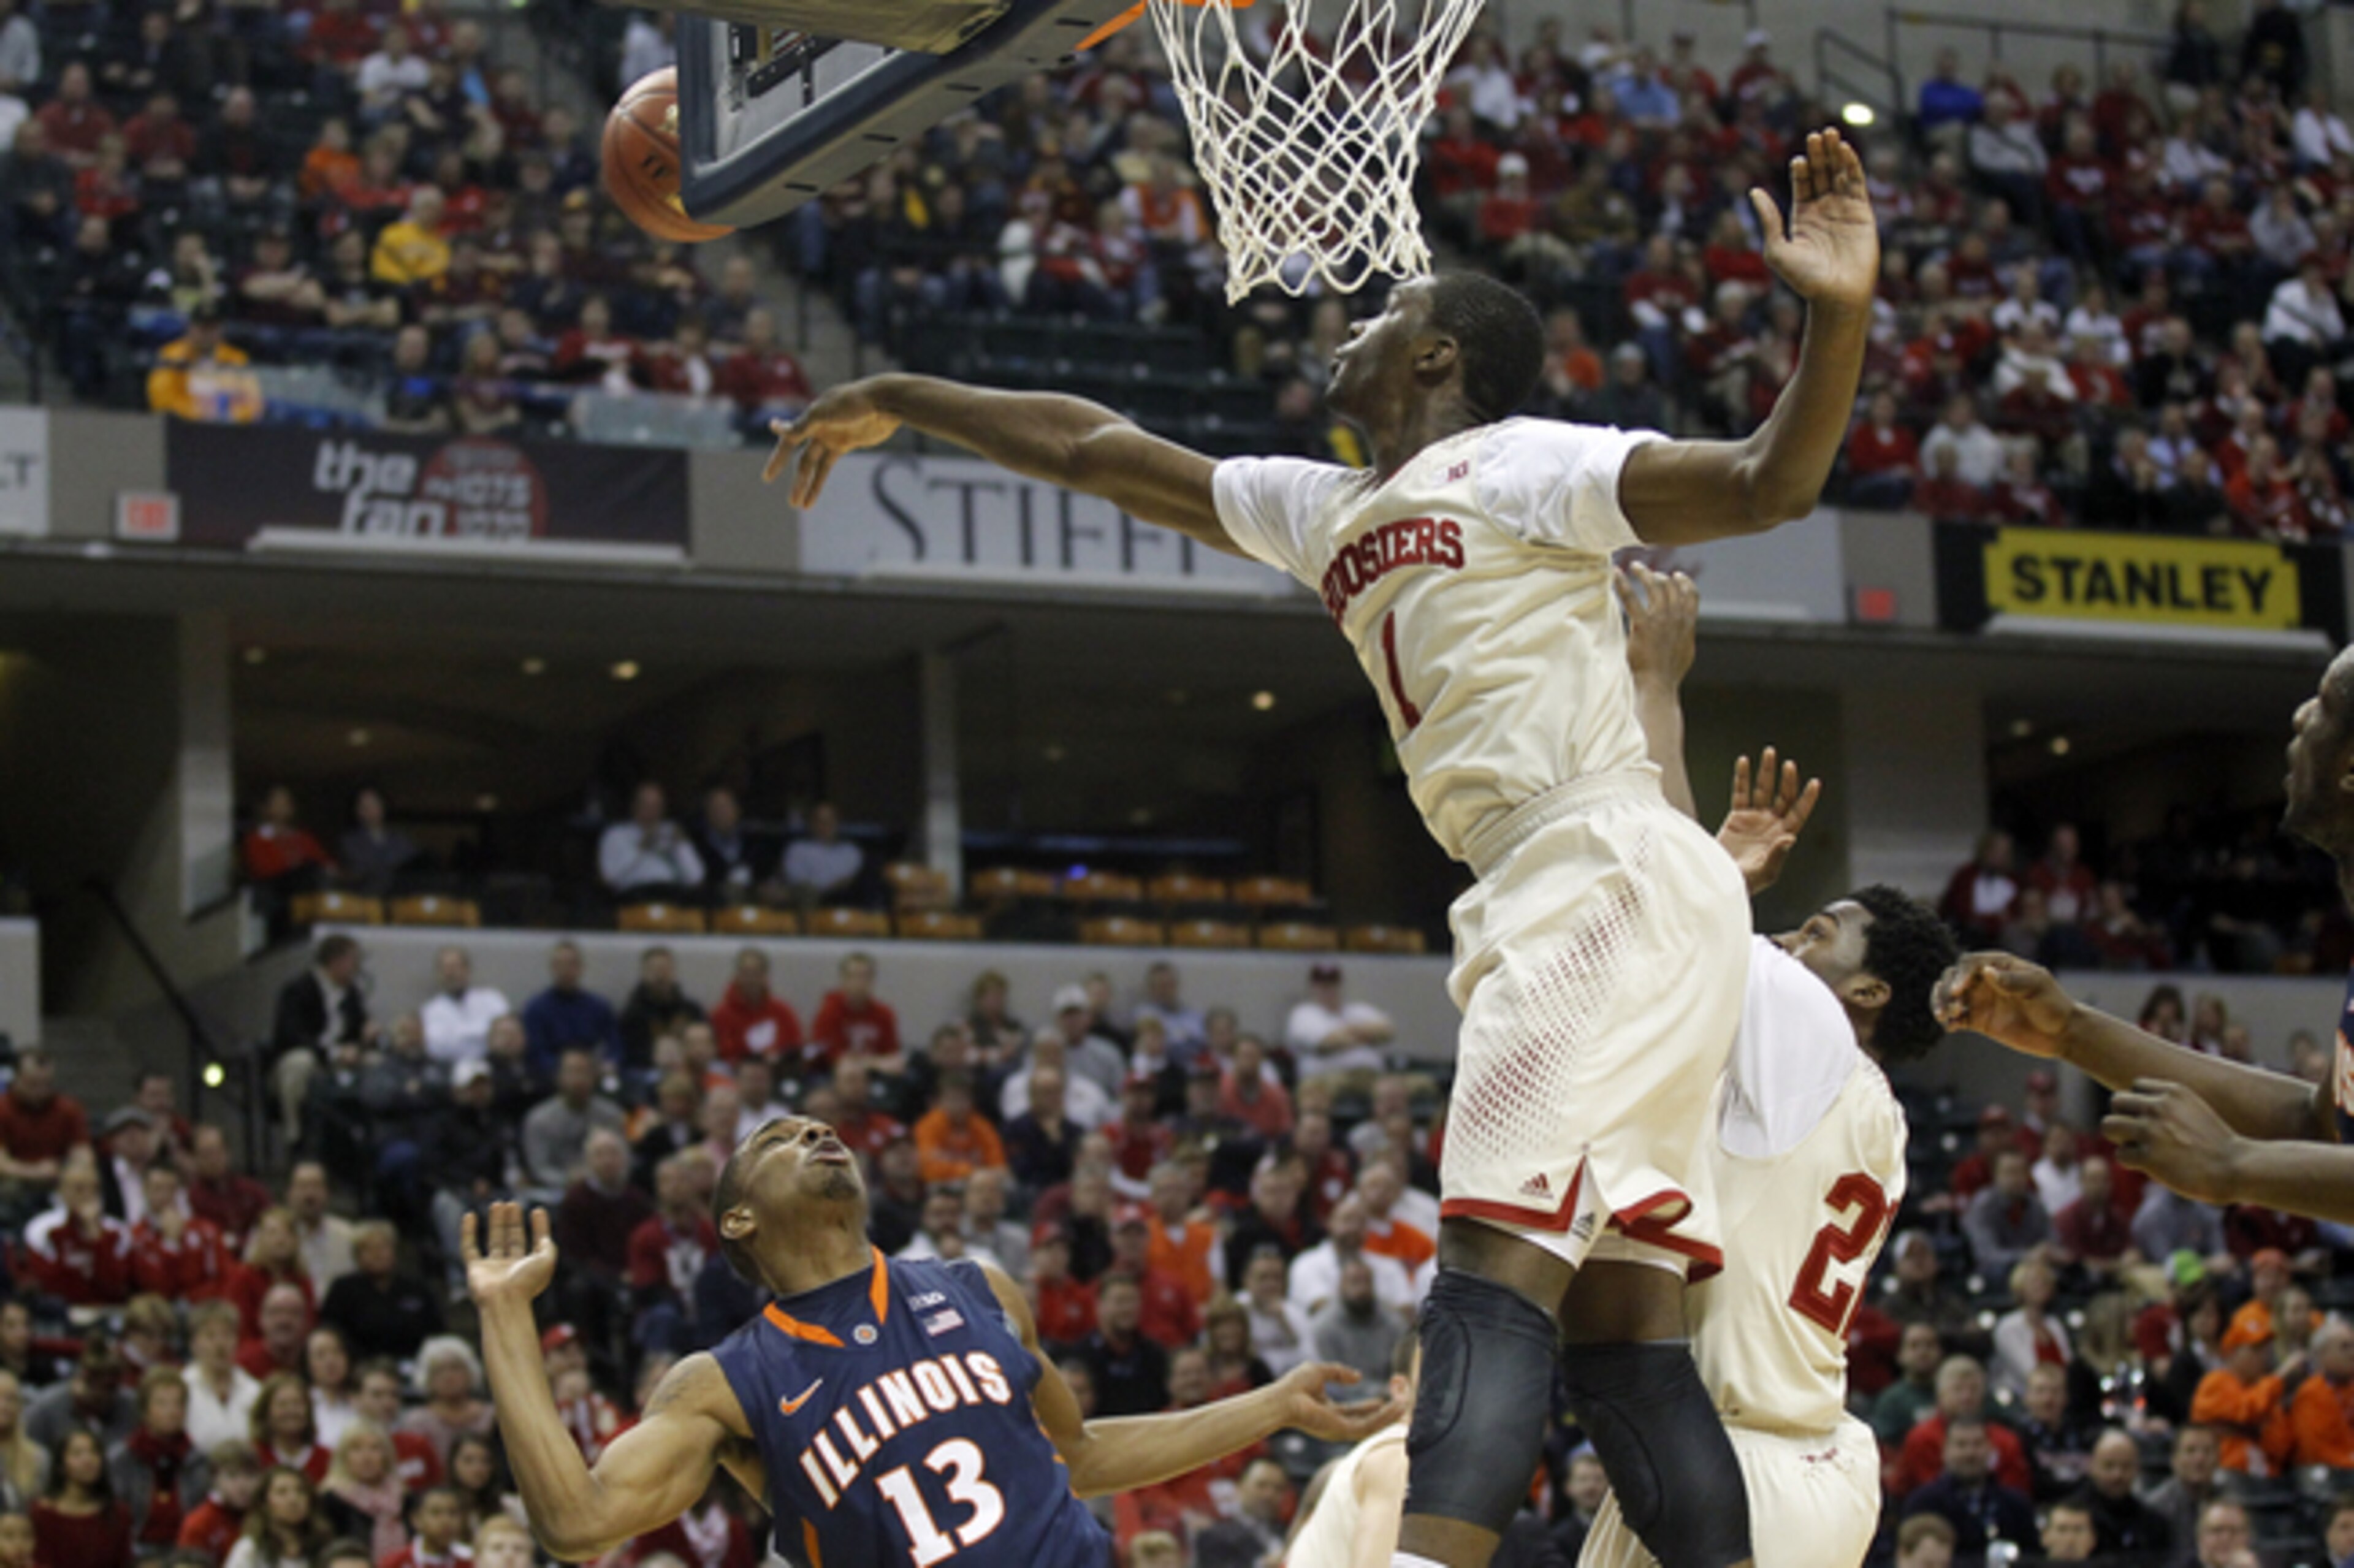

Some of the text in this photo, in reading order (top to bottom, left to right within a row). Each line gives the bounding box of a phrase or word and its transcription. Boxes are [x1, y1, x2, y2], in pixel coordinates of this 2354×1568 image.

[0, 454, 38, 490] T
[313, 440, 418, 493] the
[2011, 554, 2273, 614] STANLEY
[1382, 609, 1422, 731] 1
[799, 1351, 1012, 1511] ILLINOIS
[875, 1437, 1005, 1568] 13
